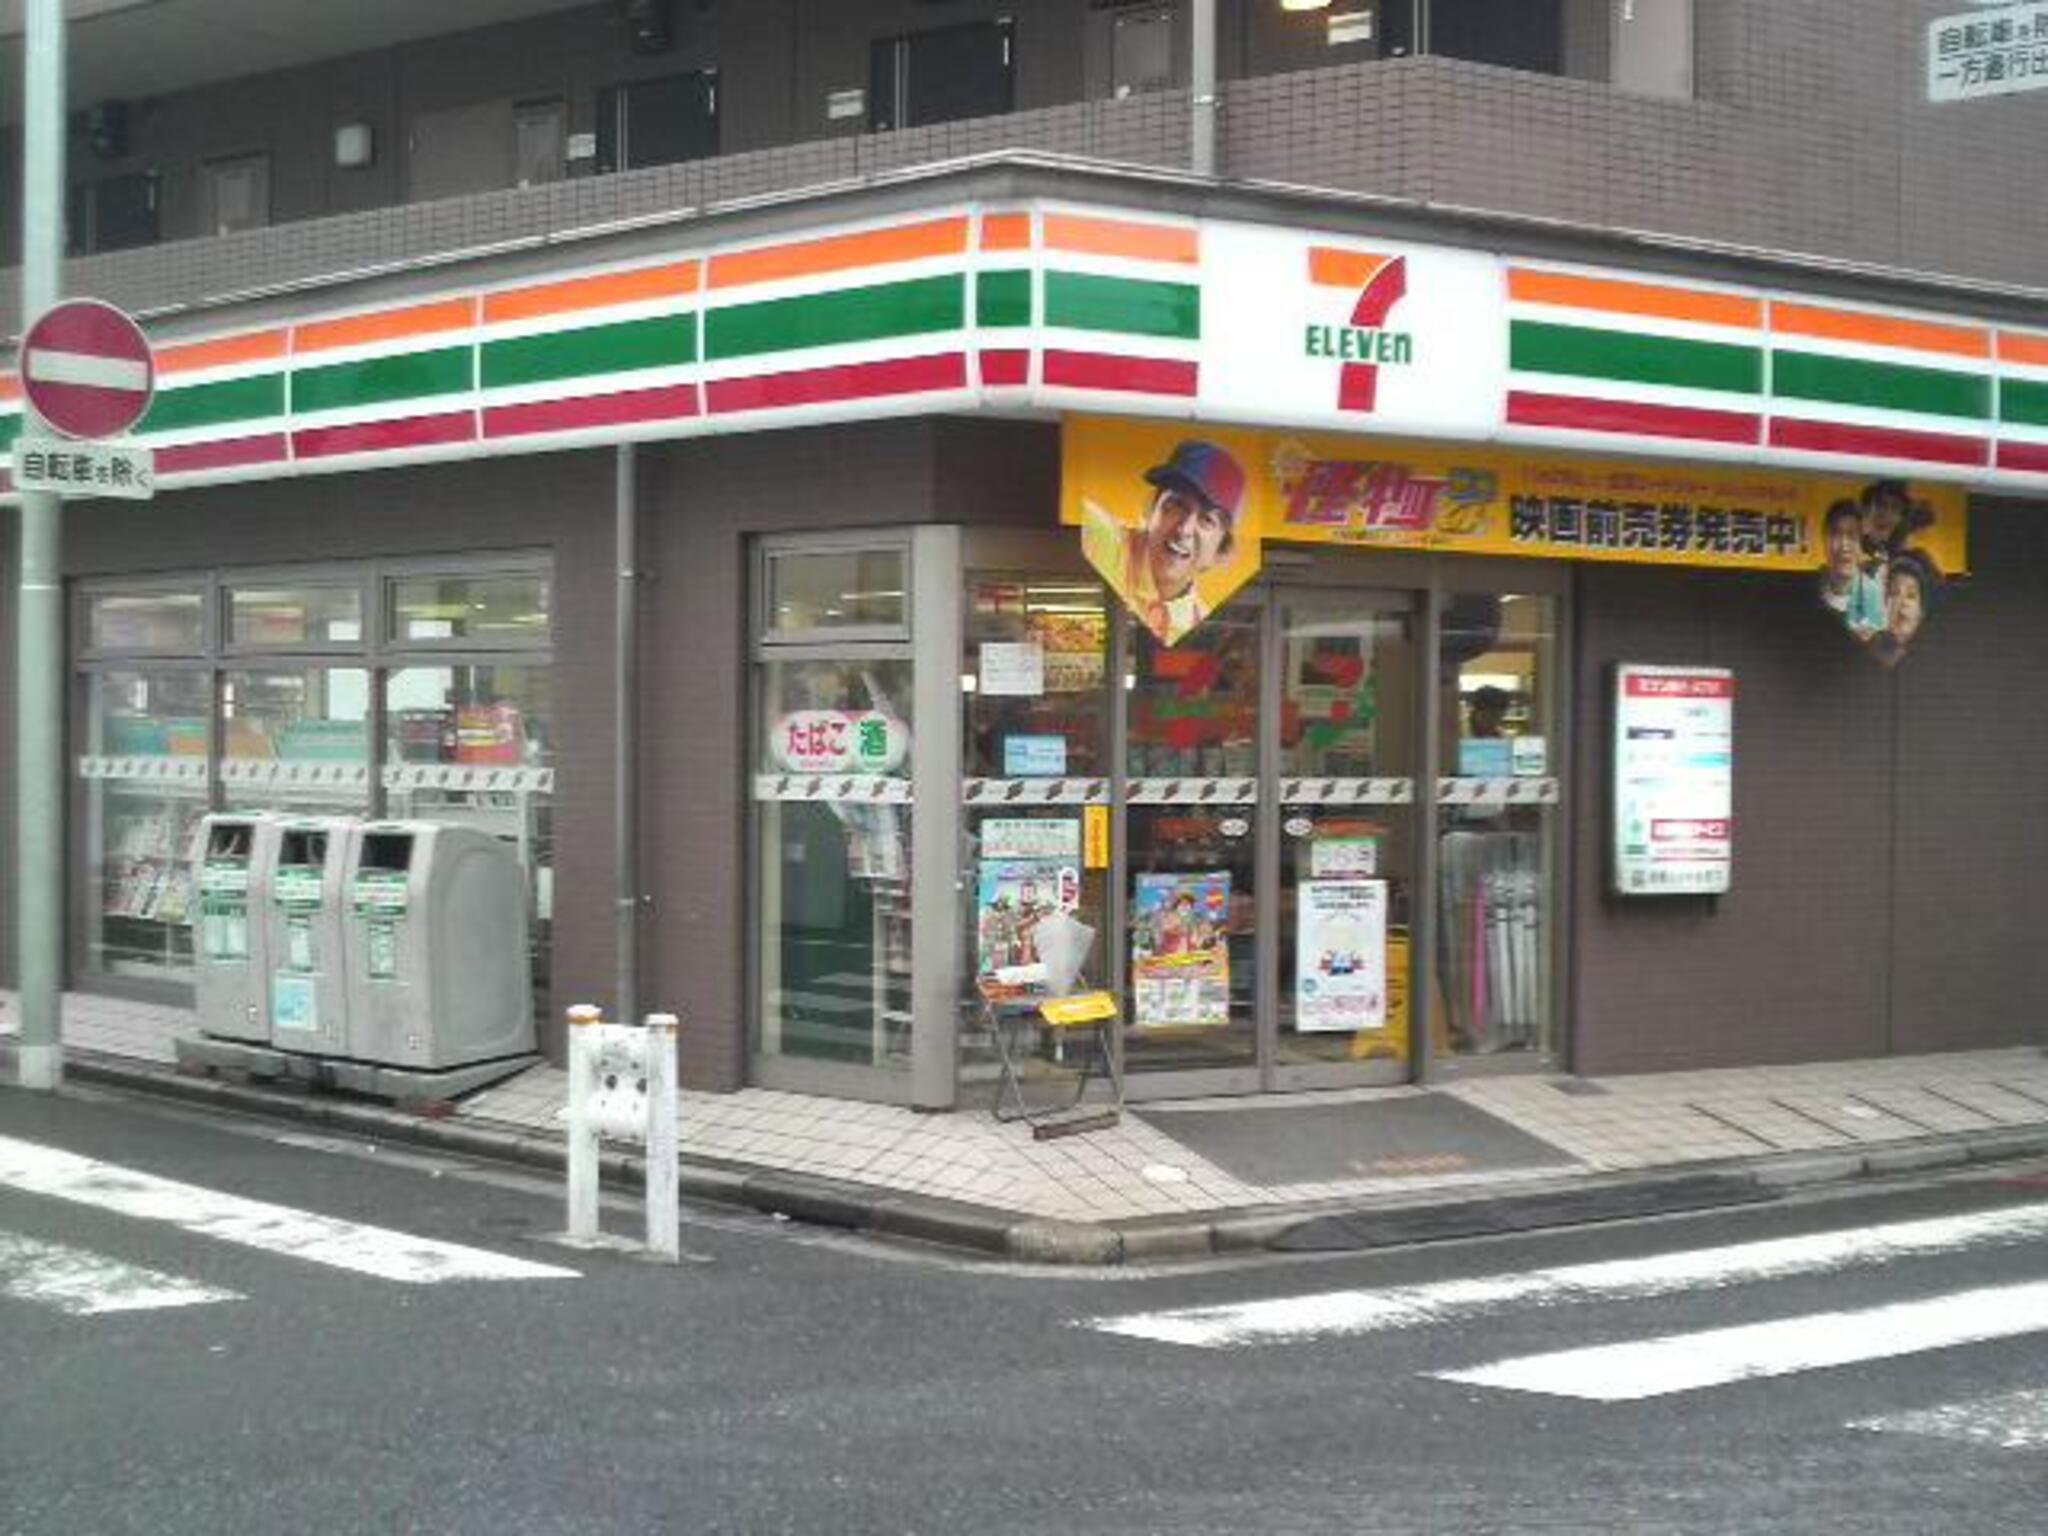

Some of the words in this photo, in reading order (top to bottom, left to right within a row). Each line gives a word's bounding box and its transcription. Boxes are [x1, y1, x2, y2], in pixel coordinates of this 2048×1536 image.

[1308, 246, 1407, 412] 7
[24, 452, 149, 488] 自転車を除く
[788, 719, 846, 756] たばこ
[859, 719, 888, 756] 酒
